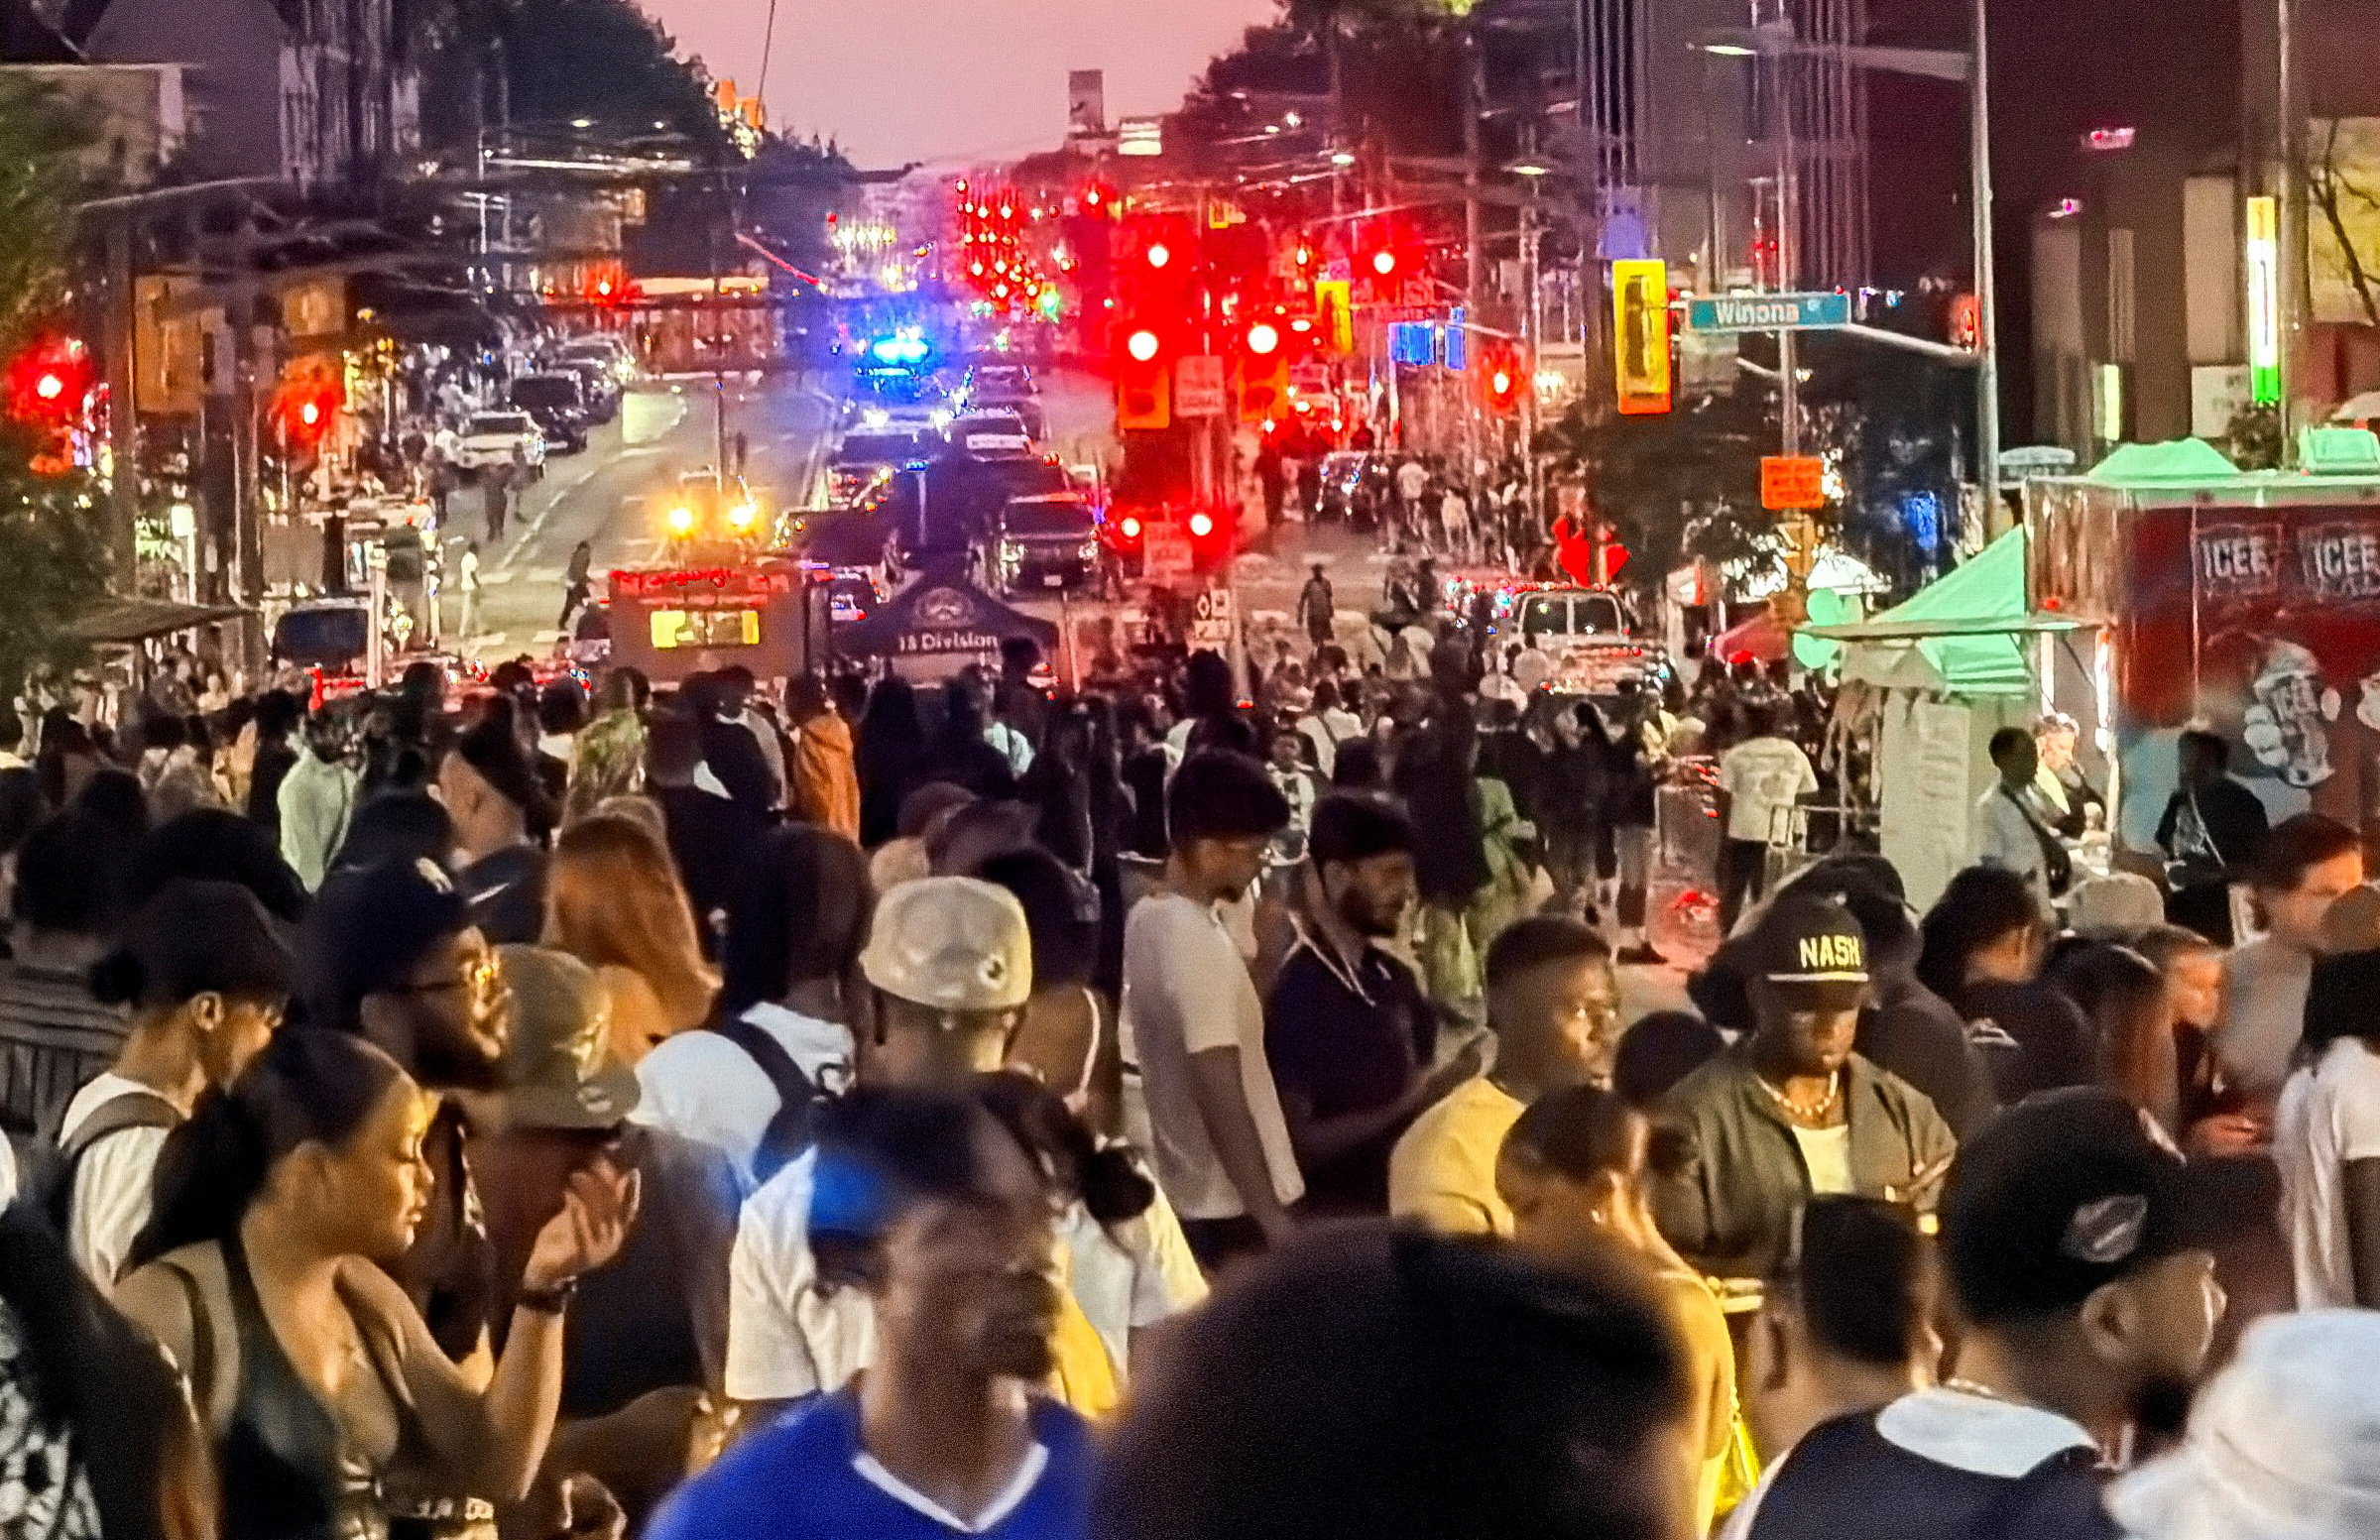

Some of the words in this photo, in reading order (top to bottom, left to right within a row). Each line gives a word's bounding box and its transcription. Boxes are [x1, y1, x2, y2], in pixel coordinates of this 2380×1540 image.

[1716, 300, 1800, 324] Winona
[2201, 534, 2271, 578] ICEE
[921, 631, 999, 651] Division
[1799, 935, 1860, 968] NASH
